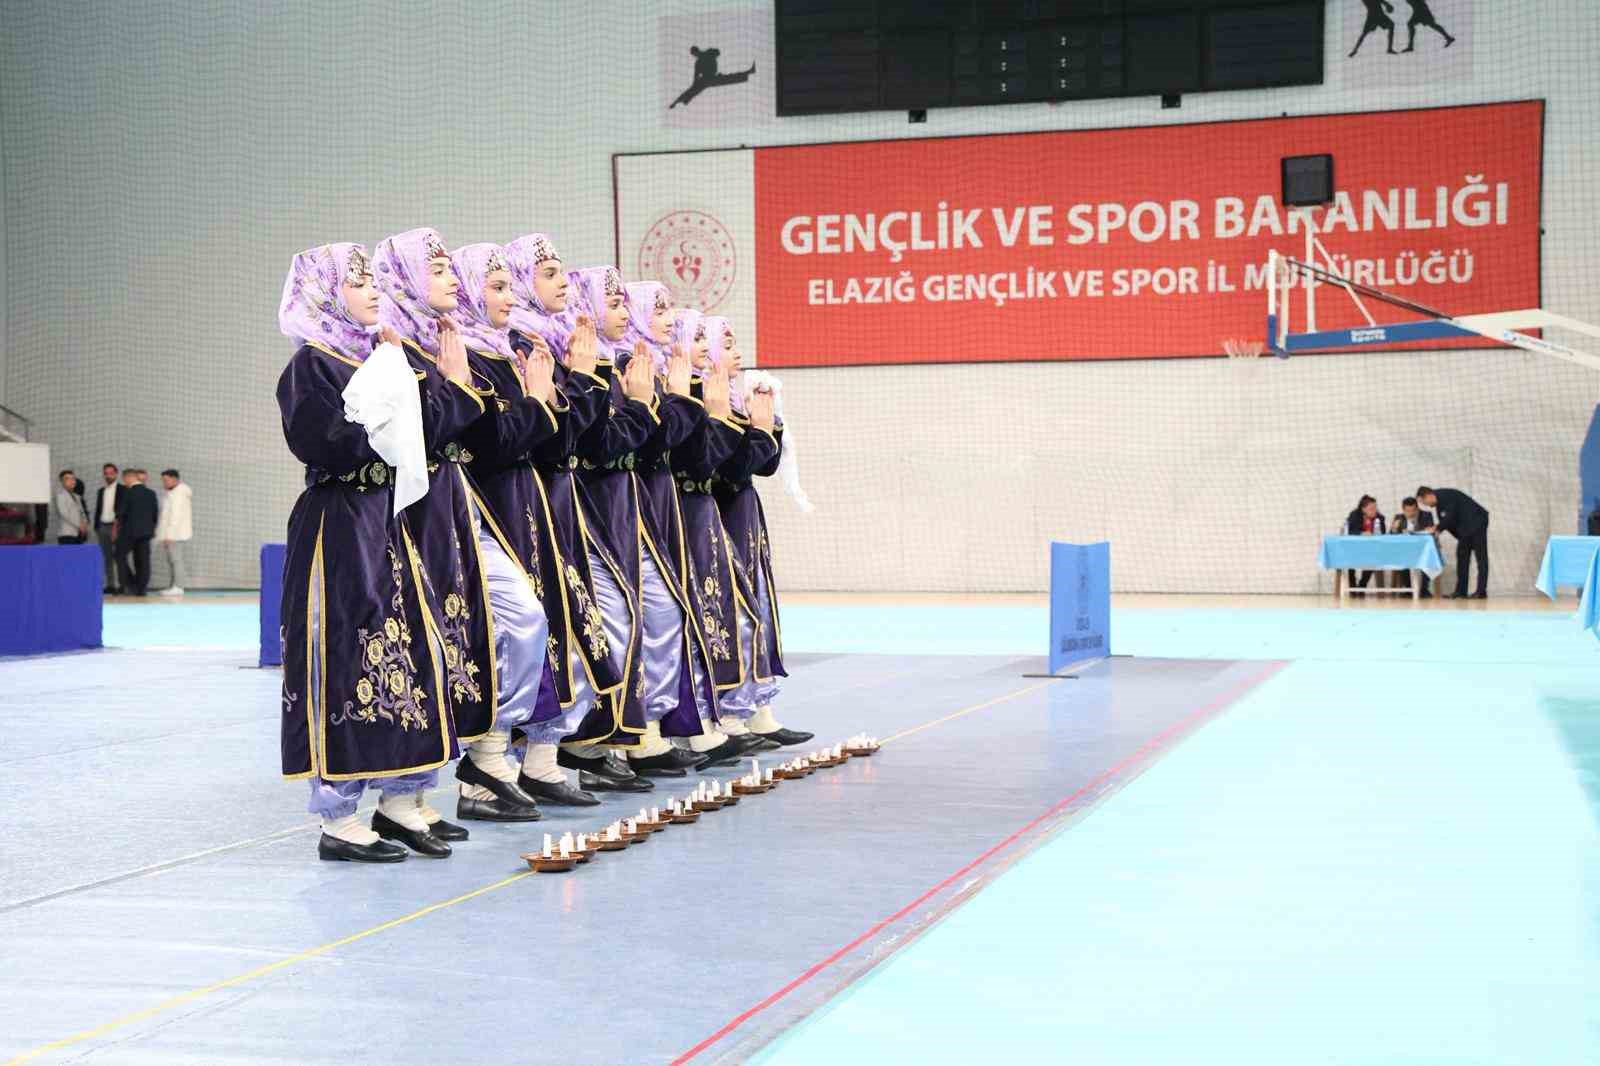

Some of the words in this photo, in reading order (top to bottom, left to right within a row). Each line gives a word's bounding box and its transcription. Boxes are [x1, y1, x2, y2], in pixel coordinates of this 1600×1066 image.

[780, 200, 984, 263] GENÇLİK
[992, 204, 1054, 248] VE
[1066, 199, 1201, 246] SPOR
[807, 269, 917, 307] ELAZIĞ
[922, 265, 1058, 307] GENÇLİK
[1063, 269, 1105, 299] VE
[1111, 264, 1200, 297] SPOR
[1206, 259, 1236, 294] İL
